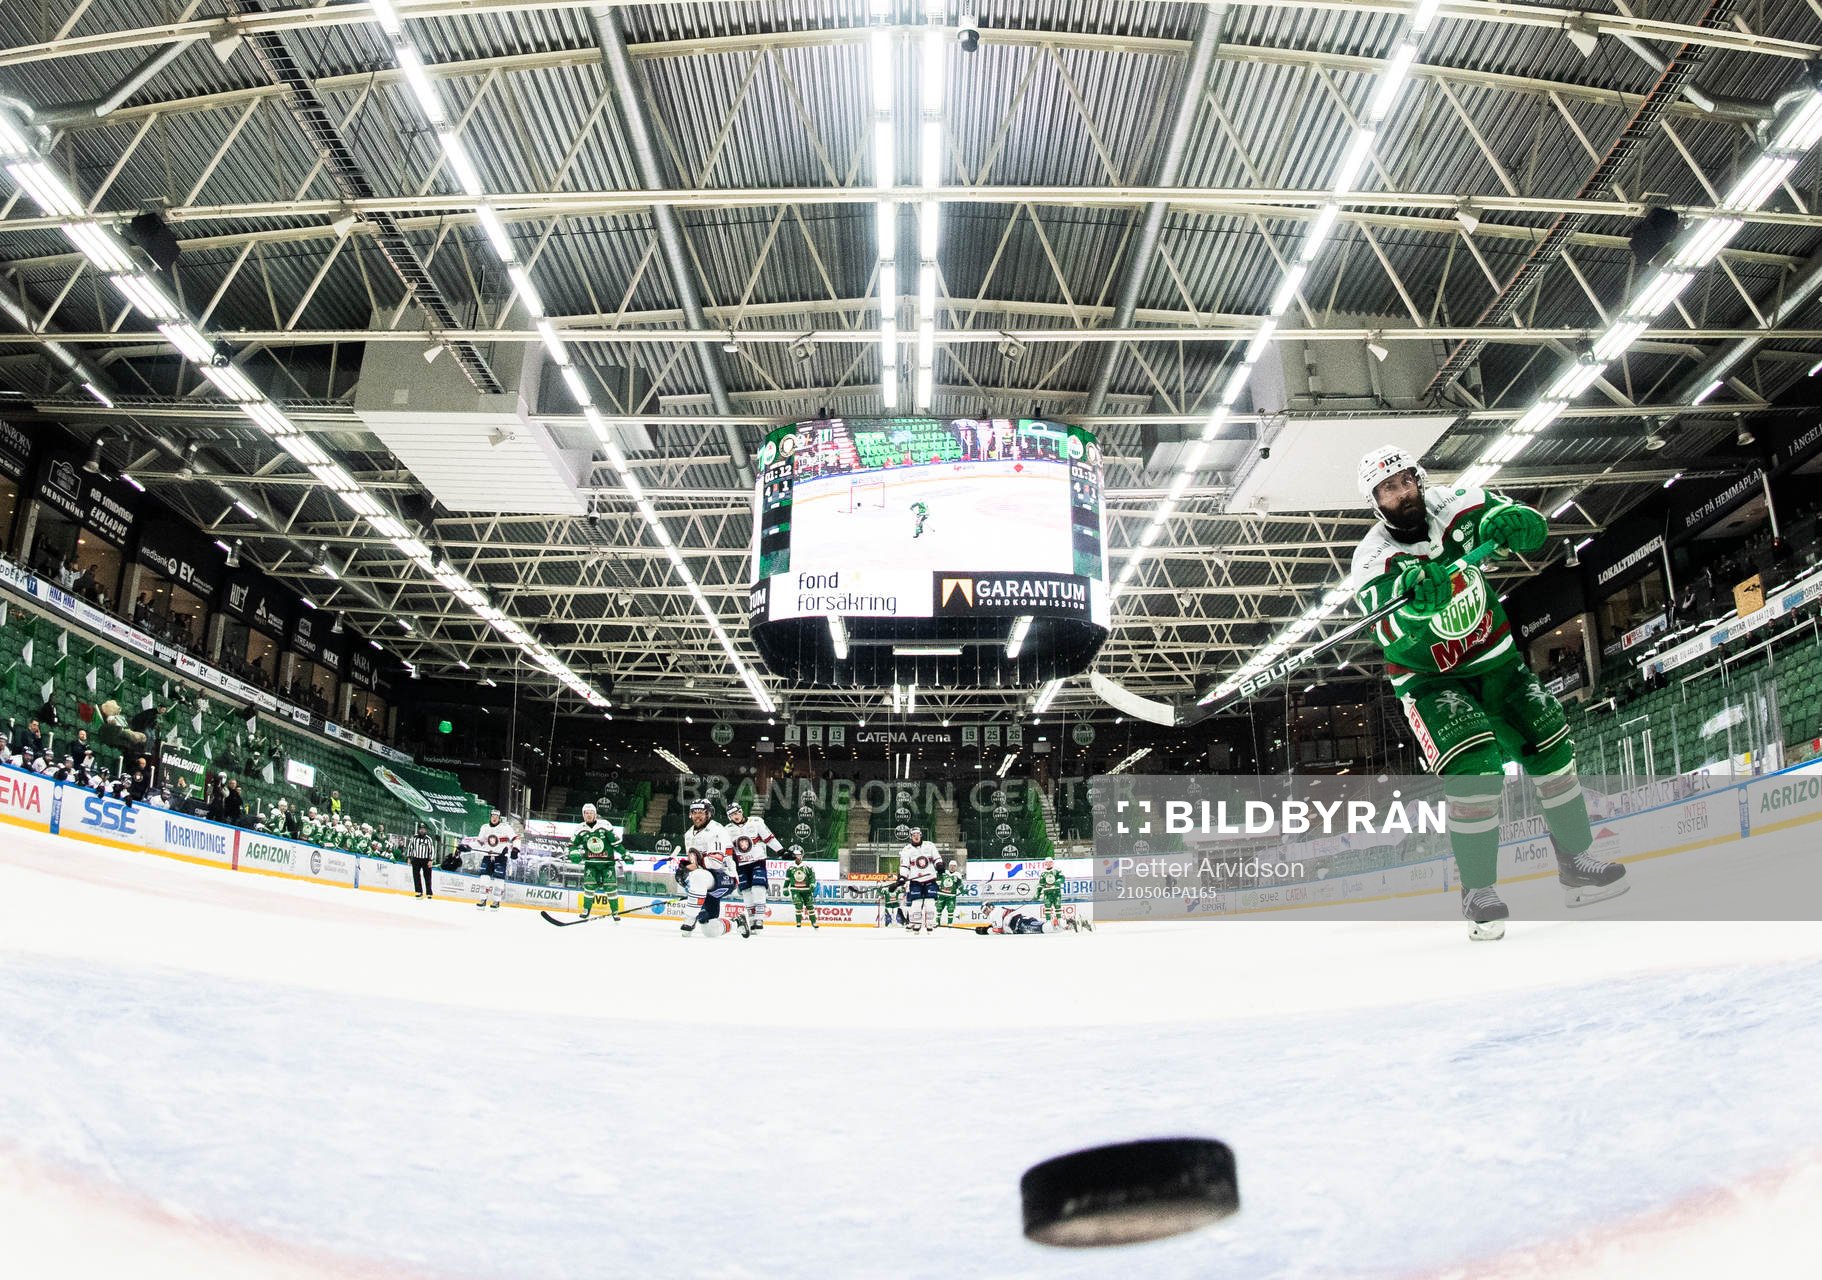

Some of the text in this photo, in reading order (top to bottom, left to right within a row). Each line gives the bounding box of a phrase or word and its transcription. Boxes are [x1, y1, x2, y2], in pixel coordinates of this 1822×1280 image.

[179, 561, 195, 583] EY
[798, 571, 839, 590] fond
[976, 580, 1086, 602] GARANTUM
[797, 593, 897, 615] försäkring
[978, 598, 1086, 610] FONDKOMMISSION
[1441, 587, 1482, 633] RÖGLE
[856, 731, 951, 743] CATENA Arena
[80, 796, 141, 835] SSE
[1683, 800, 1707, 819] INTER
[1677, 815, 1709, 835] SYSTEM
[164, 820, 226, 855] NORRVIDINGE
[245, 842, 291, 866] AGRIZON
[1514, 844, 1548, 863] AirSon
[525, 887, 563, 901] HiKOKI
